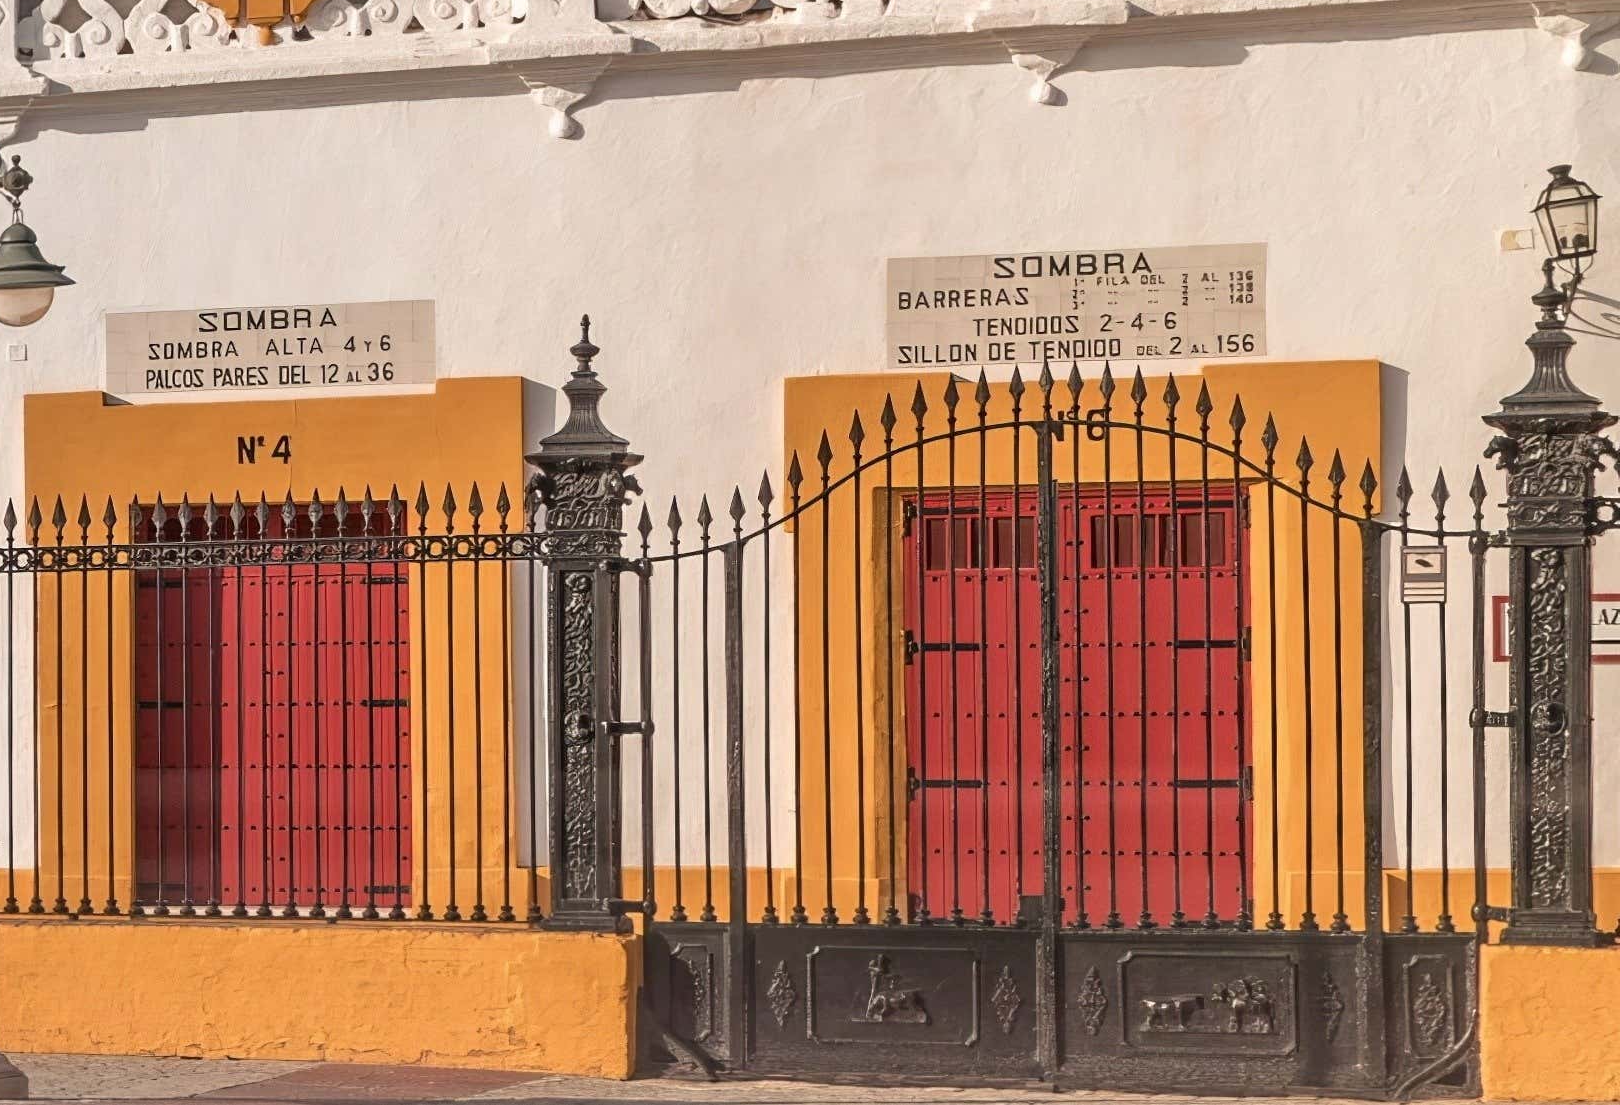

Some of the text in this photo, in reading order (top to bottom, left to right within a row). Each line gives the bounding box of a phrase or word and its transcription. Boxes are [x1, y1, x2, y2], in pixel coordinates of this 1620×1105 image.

[993, 251, 1153, 279] SOMBRA
[1096, 275, 1130, 286] FILA
[1140, 274, 1165, 285] DEL
[1200, 272, 1220, 282] AL
[1229, 270, 1254, 281] 136
[897, 287, 1029, 311] BARRERAS
[1229, 293, 1254, 304] 140
[198, 307, 338, 333] SOMBRA
[972, 315, 1080, 337] TENDIDOS
[148, 334, 391, 361] SOMBRA ALTA 4 Y 6
[897, 333, 1255, 364] SILLON DE TENDIDO DEL 2 AL 156
[145, 361, 394, 390] PALCOS PARES DEL 12 AL 36
[1086, 408, 1108, 442] 6
[271, 434, 292, 465] 4
